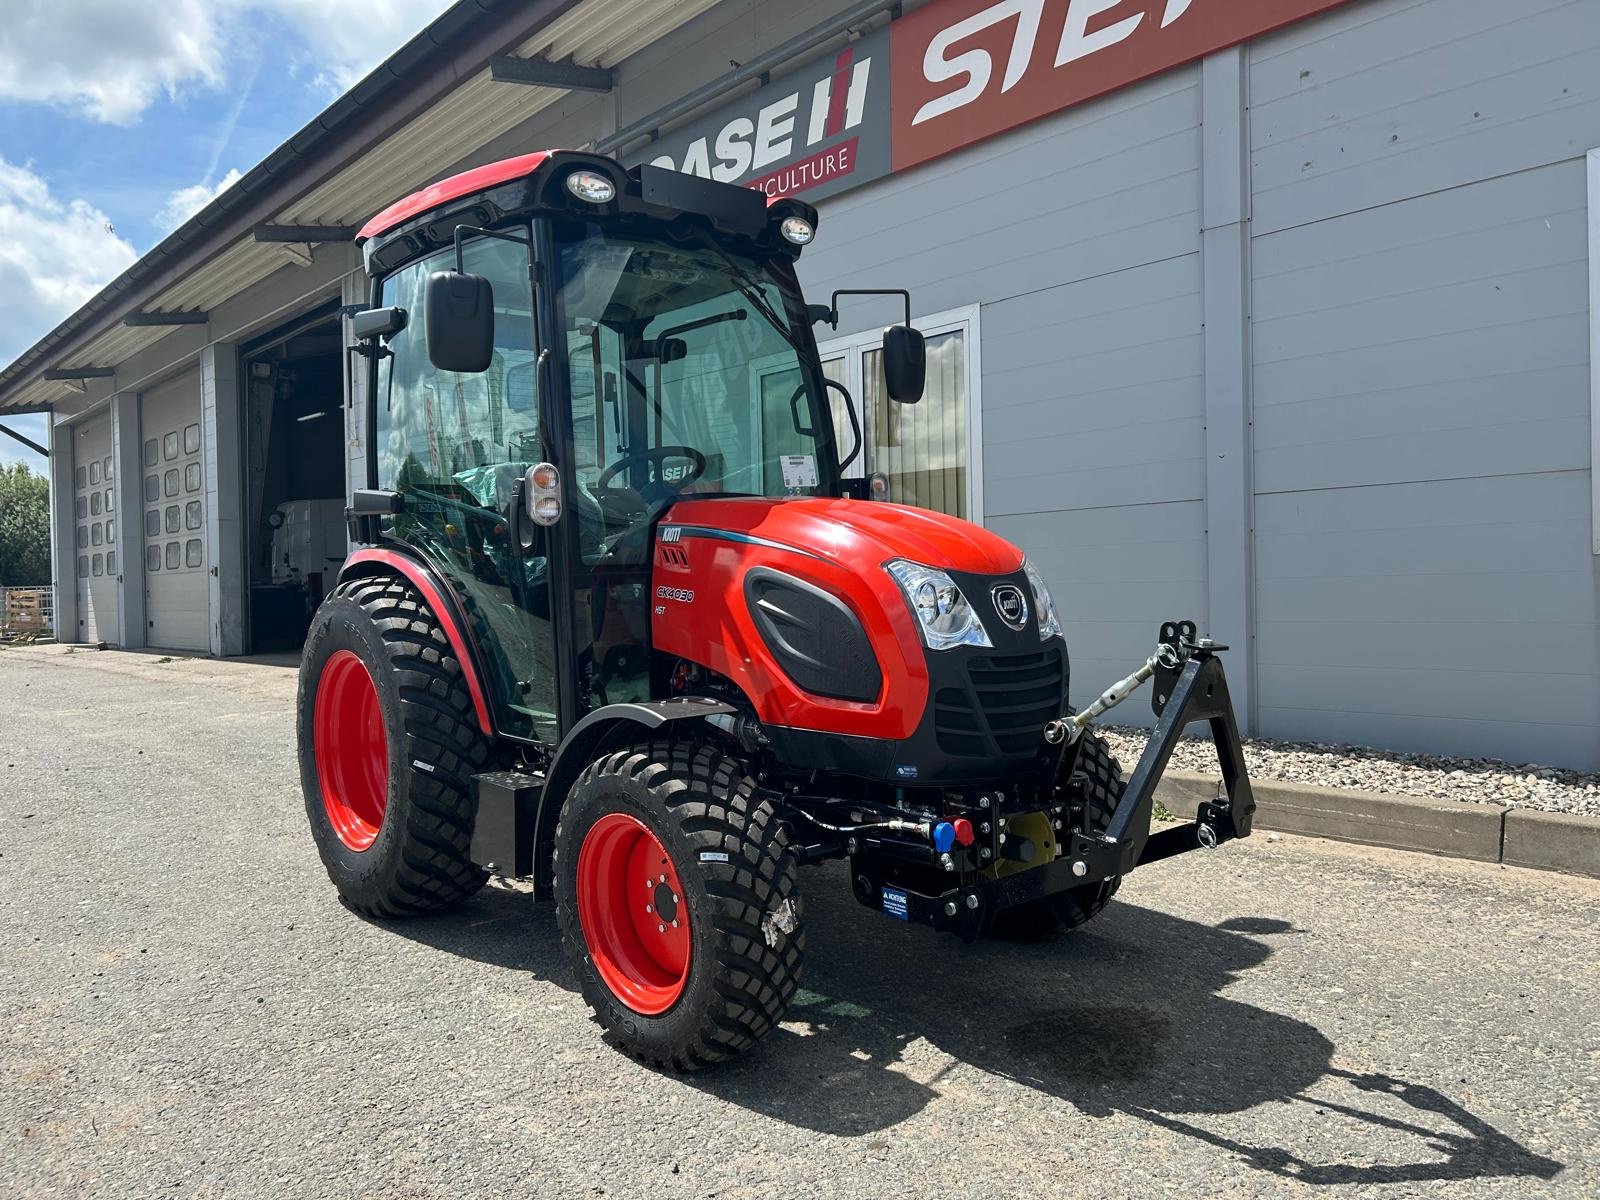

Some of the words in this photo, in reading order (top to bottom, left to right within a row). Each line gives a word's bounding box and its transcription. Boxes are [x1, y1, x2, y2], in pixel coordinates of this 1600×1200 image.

[650, 92, 799, 184] ASE
[662, 528, 681, 542] KIOTI
[657, 586, 694, 602] CK4030
[655, 606, 666, 614] HST
